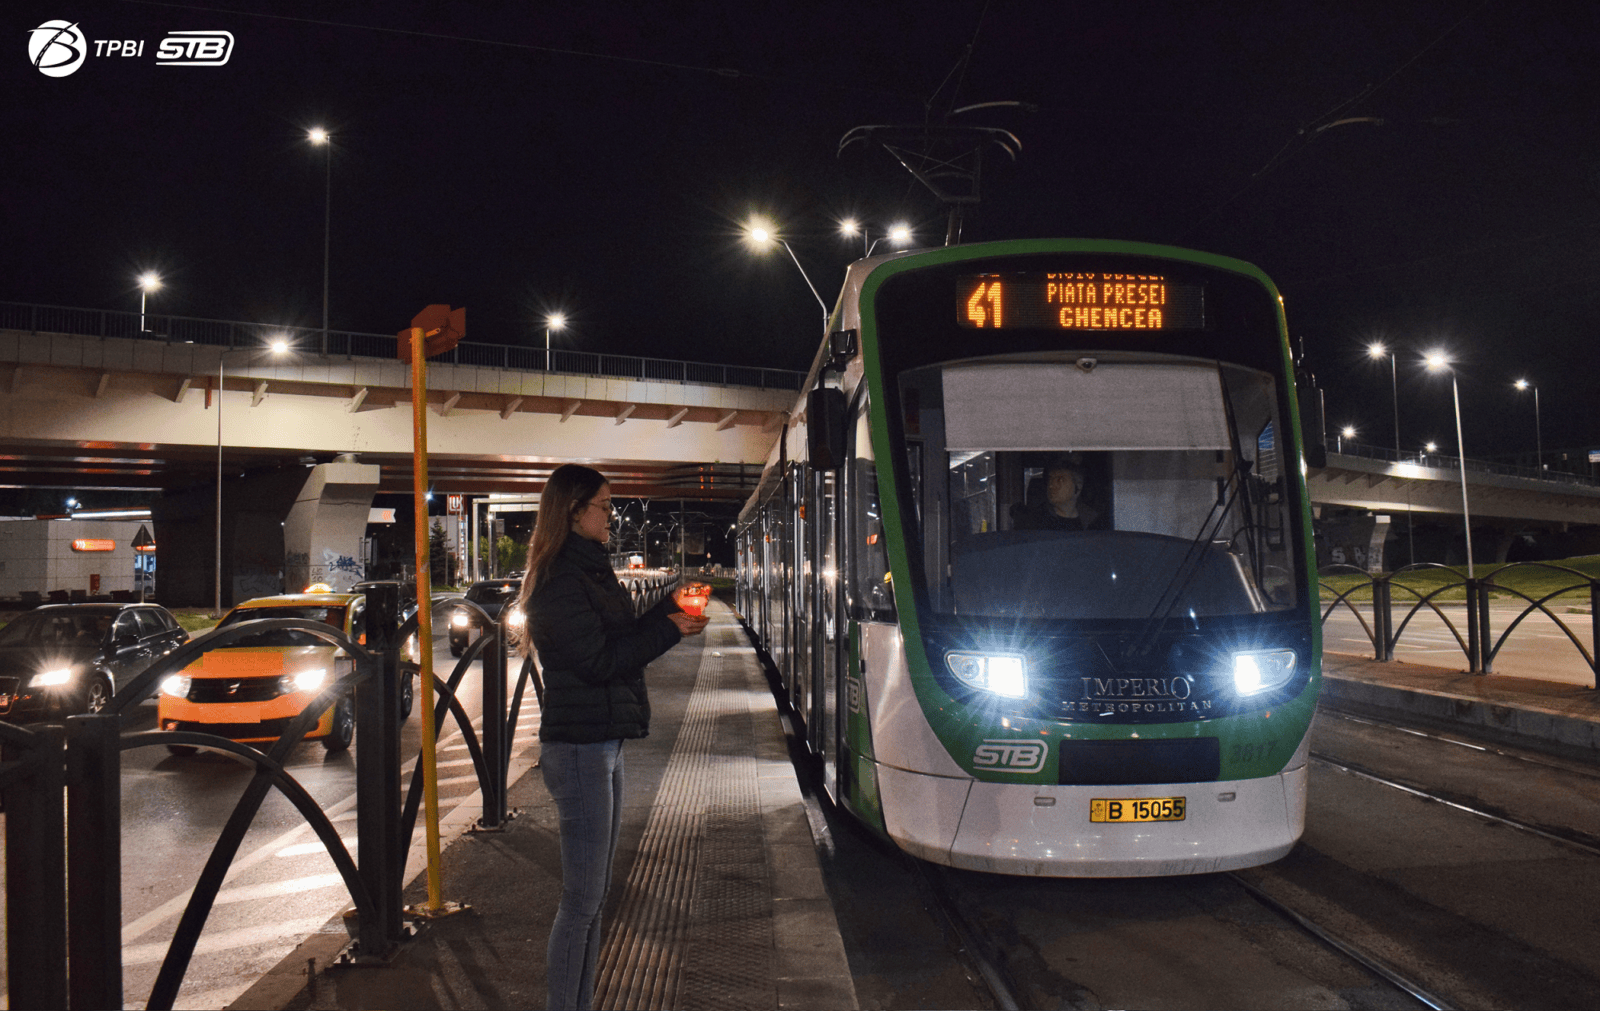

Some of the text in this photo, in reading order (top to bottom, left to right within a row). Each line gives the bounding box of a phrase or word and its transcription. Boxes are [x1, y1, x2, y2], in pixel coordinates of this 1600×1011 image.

[1047, 282, 1165, 304] PIATA PRESEI
[968, 282, 1001, 328] 41
[1081, 676, 1191, 700] IMPERIO
[1062, 700, 1212, 713] METROPOLITAN
[973, 745, 1041, 766] STB
[1109, 800, 1184, 819] B 15055
